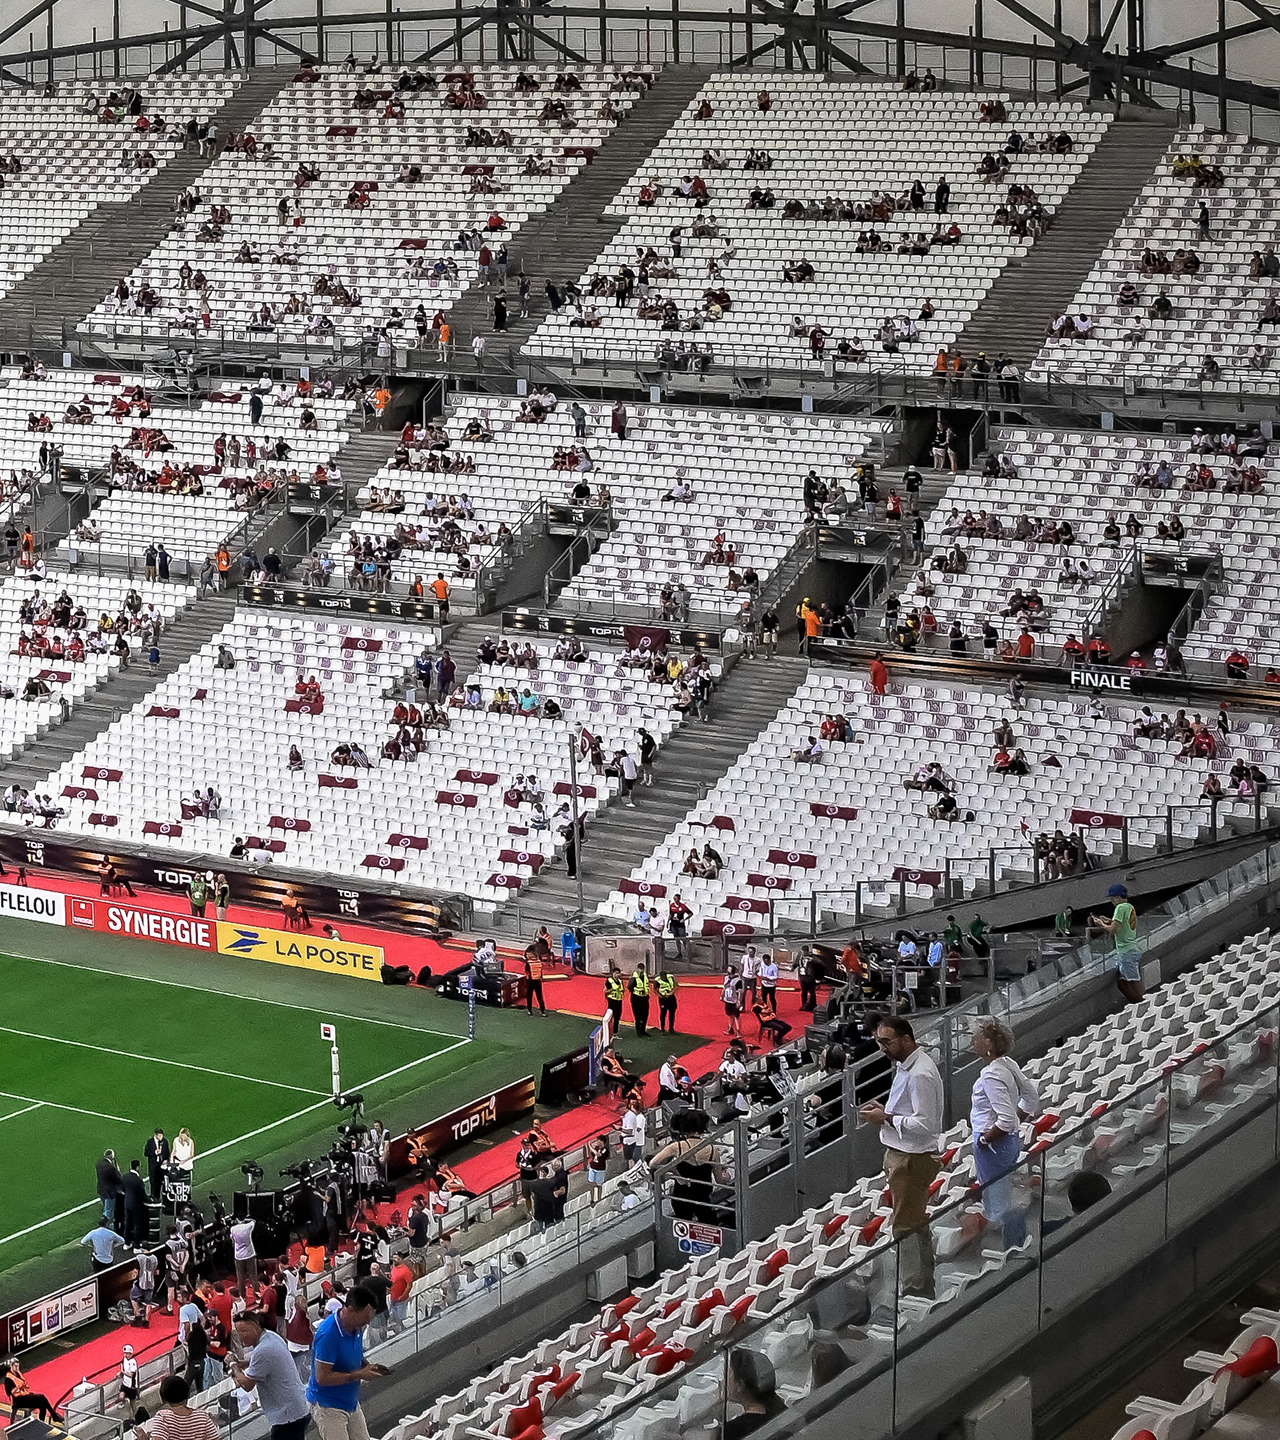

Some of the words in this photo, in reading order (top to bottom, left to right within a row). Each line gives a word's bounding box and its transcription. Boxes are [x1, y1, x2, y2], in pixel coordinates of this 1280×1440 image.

[1070, 671, 1131, 690] FINALE
[337, 889, 359, 898] TOP
[107, 906, 211, 948] SYNERGIE
[275, 940, 301, 959] LA
[306, 944, 374, 971] POSTE
[451, 1107, 496, 1140] TOP14
[12, 1320, 25, 1331] TOP
